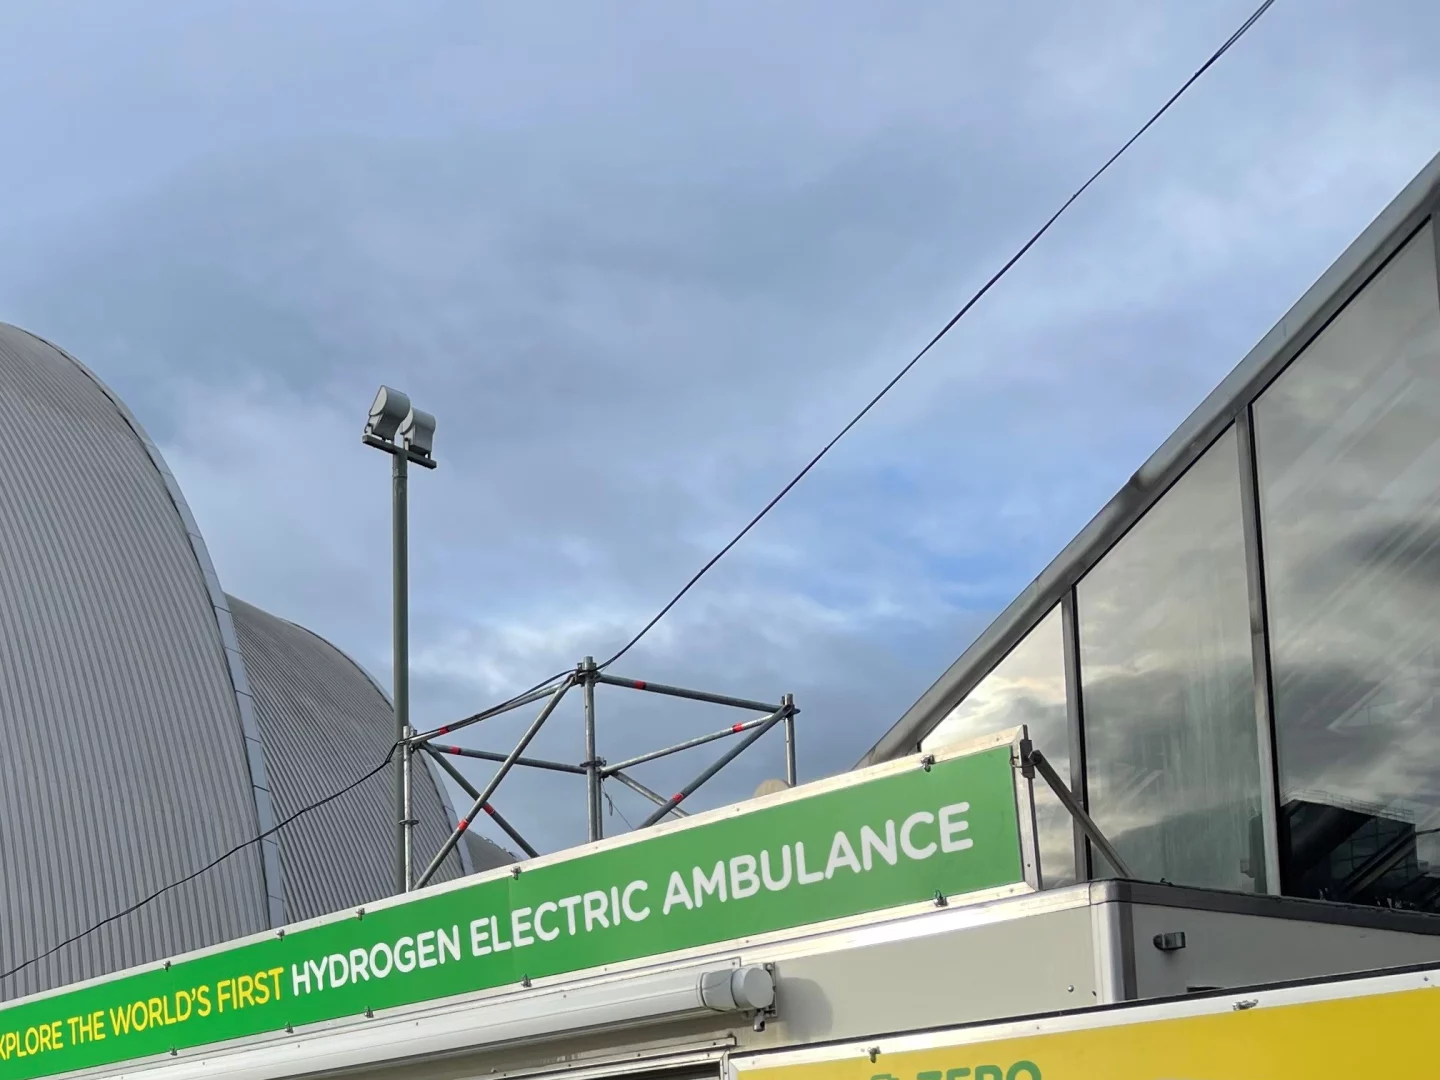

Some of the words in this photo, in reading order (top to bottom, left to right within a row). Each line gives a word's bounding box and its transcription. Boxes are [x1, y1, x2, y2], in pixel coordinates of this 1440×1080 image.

[67, 1012, 104, 1047] THE
[109, 985, 211, 1036] WORLD'S
[217, 967, 284, 1010] FIRST
[292, 924, 461, 997] HYDROGEN
[469, 879, 650, 957] ELECTRIC
[662, 801, 974, 916] AMBULANCE
